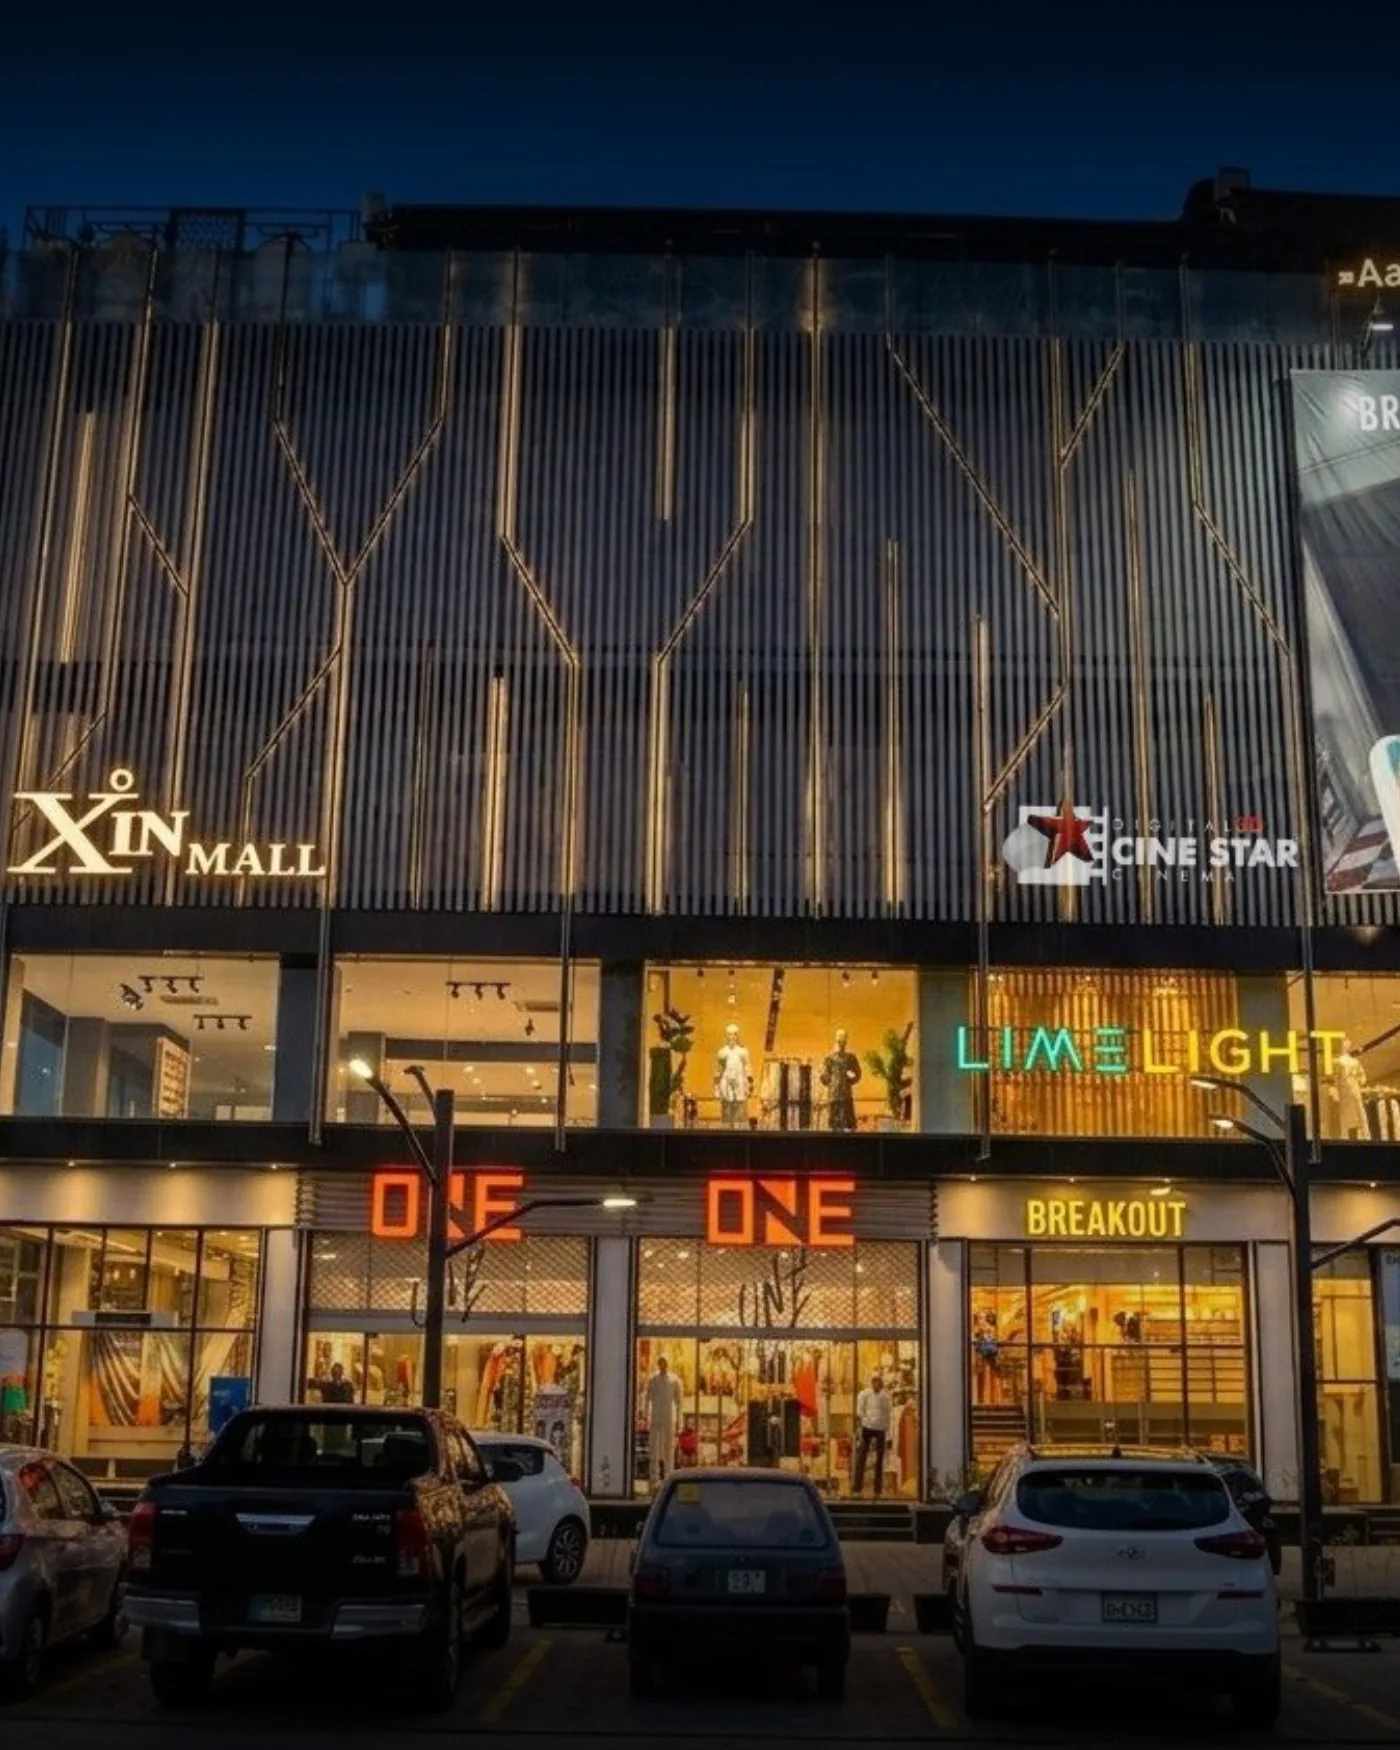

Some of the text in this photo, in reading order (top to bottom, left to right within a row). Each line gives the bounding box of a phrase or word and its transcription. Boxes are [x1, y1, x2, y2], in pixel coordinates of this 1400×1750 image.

[185, 843, 326, 876] MALL
[1112, 837, 1299, 868] CINE STAR
[1111, 867, 1236, 883] CNEMA
[957, 1025, 1347, 1076] LIMELIGHT
[371, 1170, 525, 1241] ONE
[707, 1177, 856, 1247] ONE
[1027, 1199, 1187, 1238] BREAKOUT
